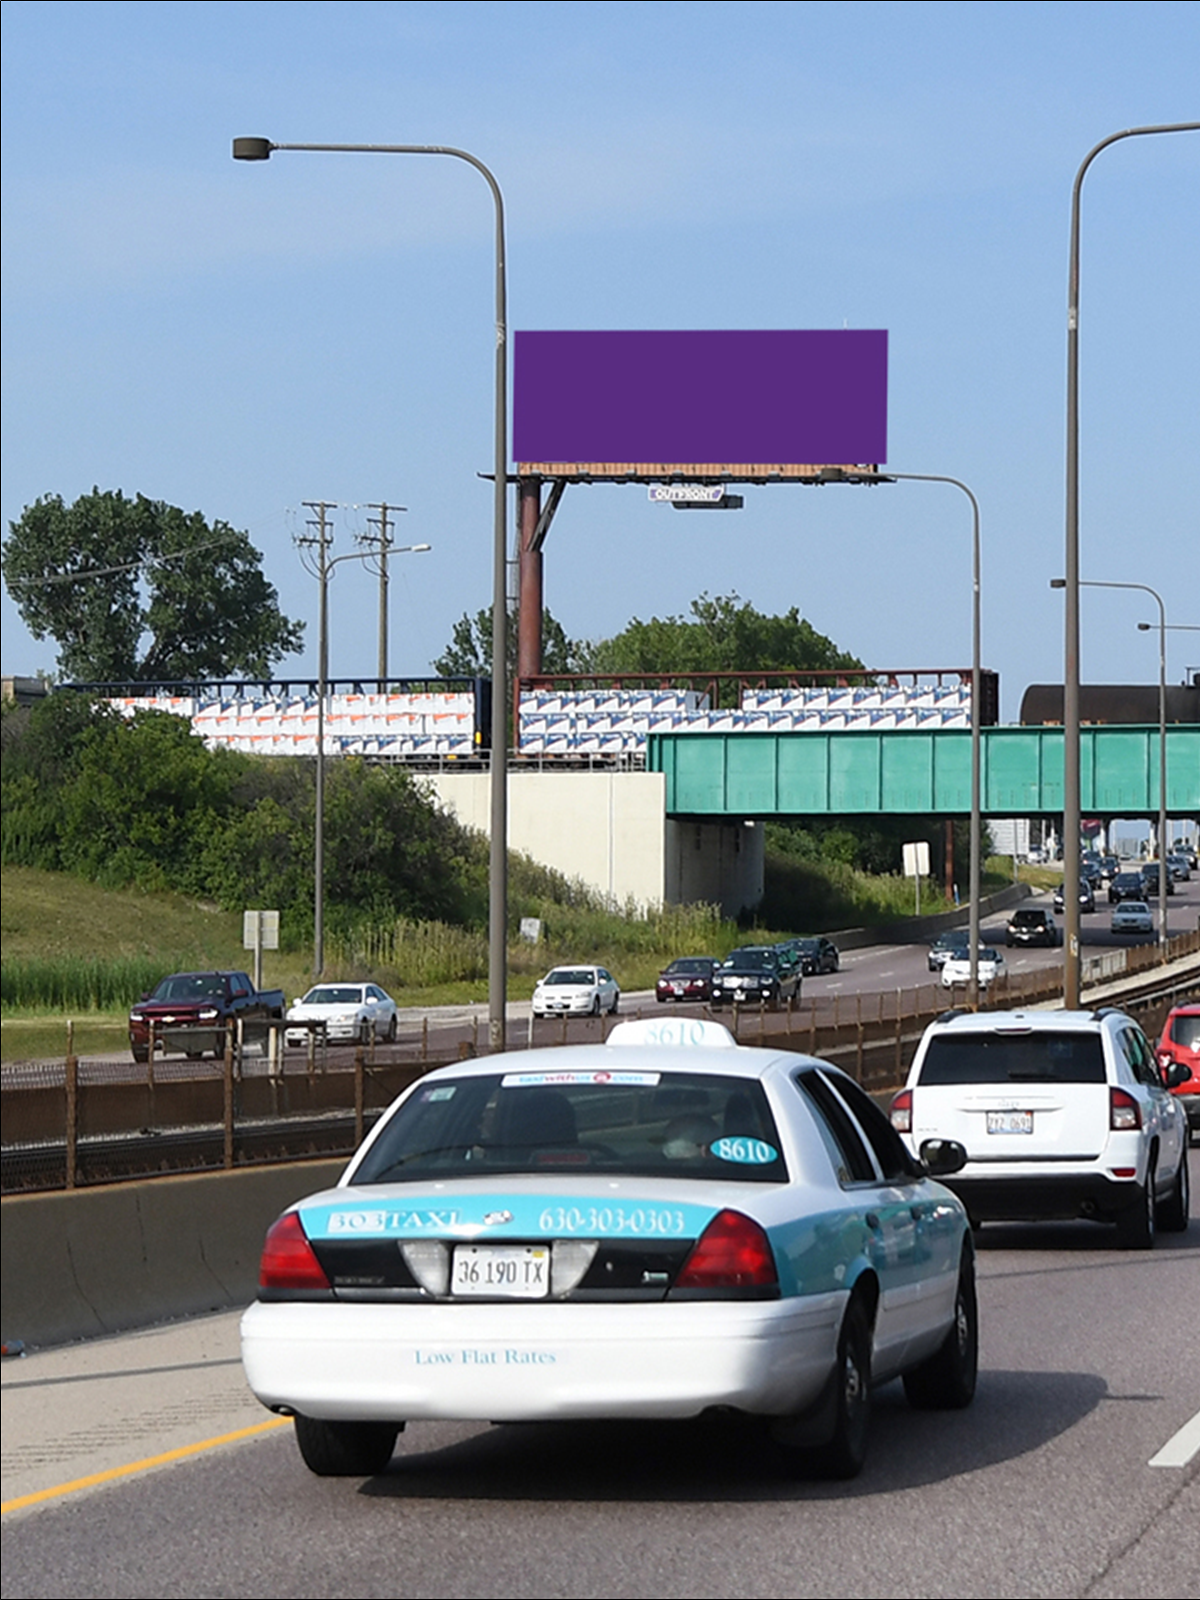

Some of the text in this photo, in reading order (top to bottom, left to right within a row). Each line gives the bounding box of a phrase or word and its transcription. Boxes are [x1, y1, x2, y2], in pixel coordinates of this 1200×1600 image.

[645, 1021, 705, 1046] 8610
[719, 1138, 769, 1164] 8610
[539, 1207, 685, 1233] 630-303-0303
[458, 1260, 544, 1284] 36 190 TX
[414, 1348, 557, 1365] Low Flat Rates
